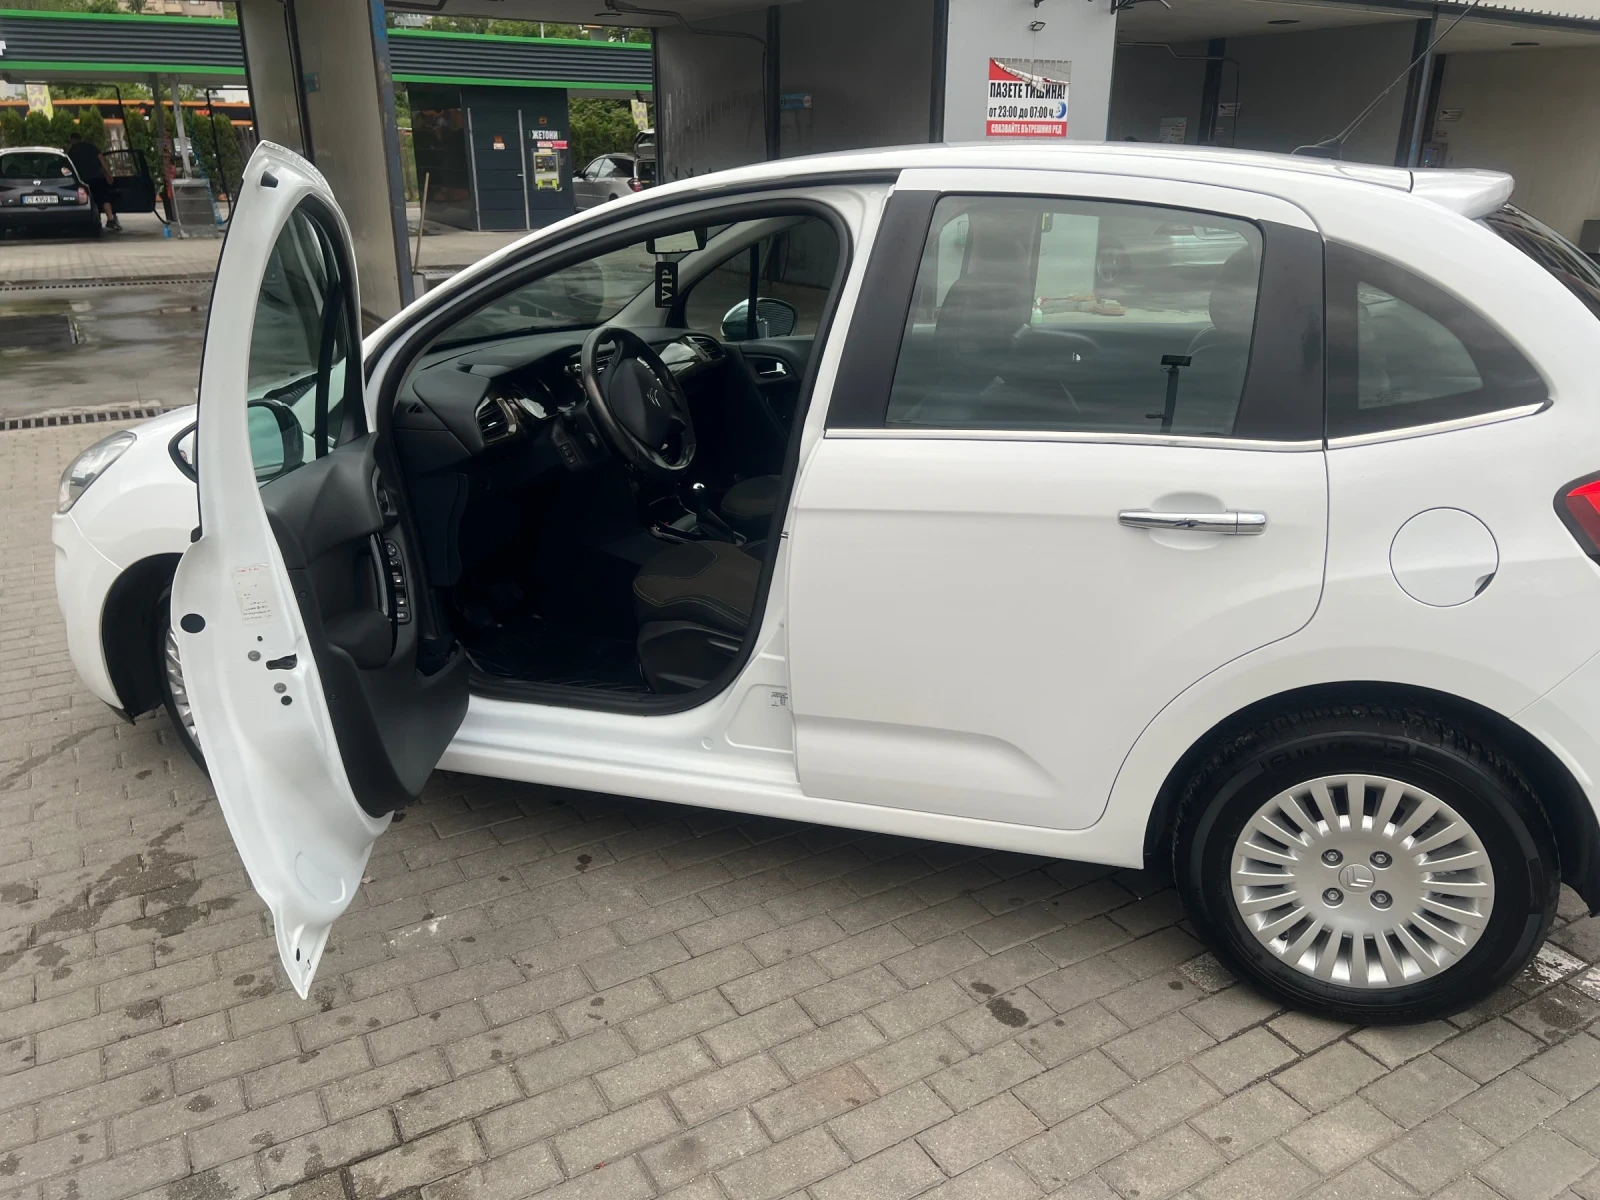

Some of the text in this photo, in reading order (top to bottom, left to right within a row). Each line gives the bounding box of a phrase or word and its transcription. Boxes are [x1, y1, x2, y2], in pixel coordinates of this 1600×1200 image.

[990, 82, 1023, 98] ПАЗЕТЕ
[989, 107, 997, 117] от
[998, 105, 1018, 118] 23:00
[1018, 108, 1028, 119] до
[1029, 106, 1048, 118] 07:00
[532, 130, 558, 140] ЖЕТОНИ
[661, 269, 673, 301] VIP
